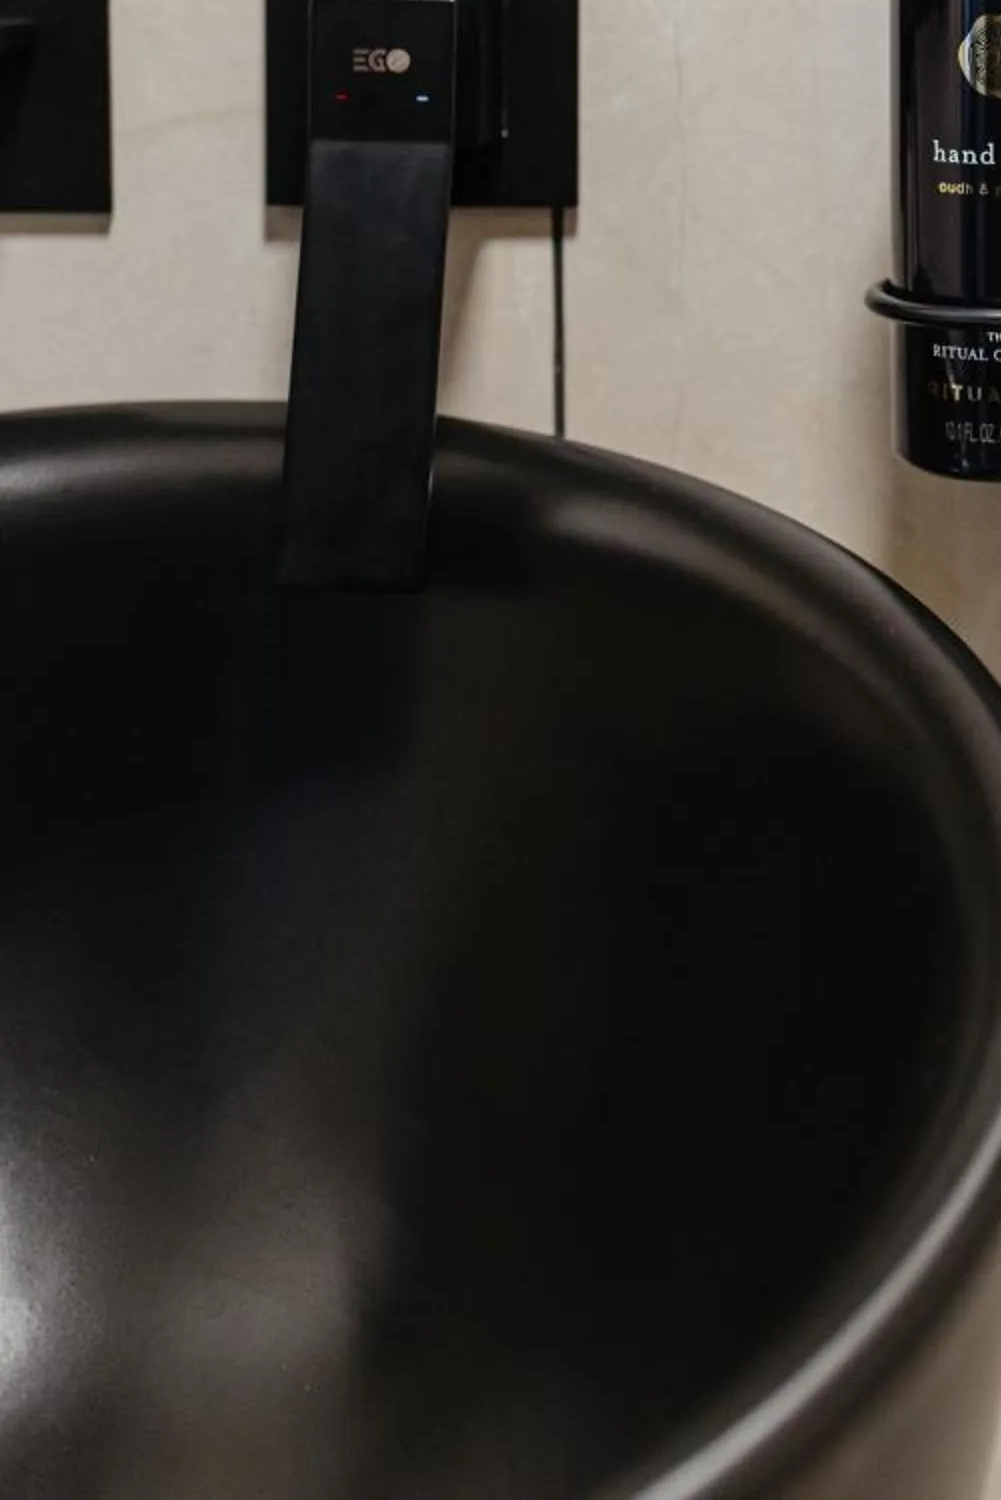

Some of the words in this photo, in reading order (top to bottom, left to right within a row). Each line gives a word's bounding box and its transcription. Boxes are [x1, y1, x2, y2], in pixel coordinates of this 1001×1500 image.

[352, 48, 411, 73] EGO
[933, 139, 997, 165] hand
[932, 343, 988, 362] RITUAL
